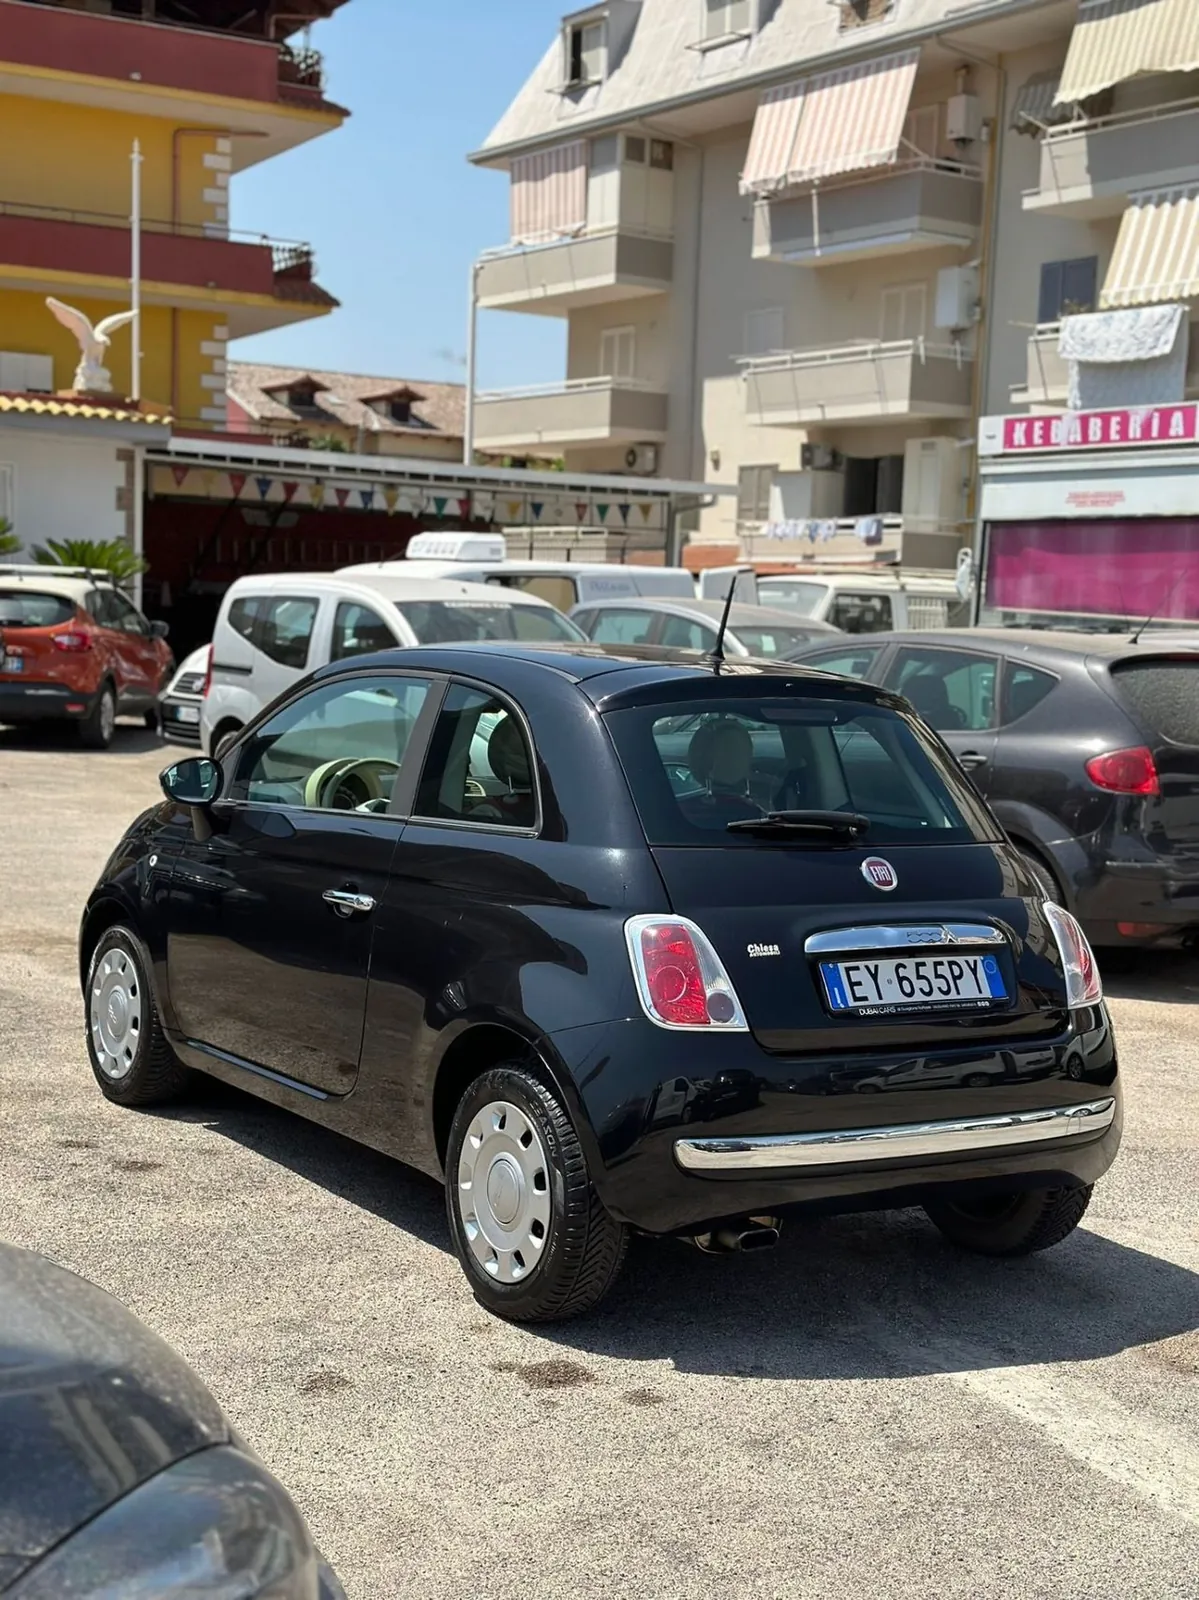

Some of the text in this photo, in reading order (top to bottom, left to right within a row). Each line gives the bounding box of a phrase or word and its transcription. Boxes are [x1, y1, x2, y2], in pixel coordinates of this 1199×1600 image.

[869, 865, 892, 881] FIAT
[844, 959, 983, 1003] EY 655PY
[858, 1007, 879, 1016] DUBAI
[879, 1005, 897, 1014] CARS
